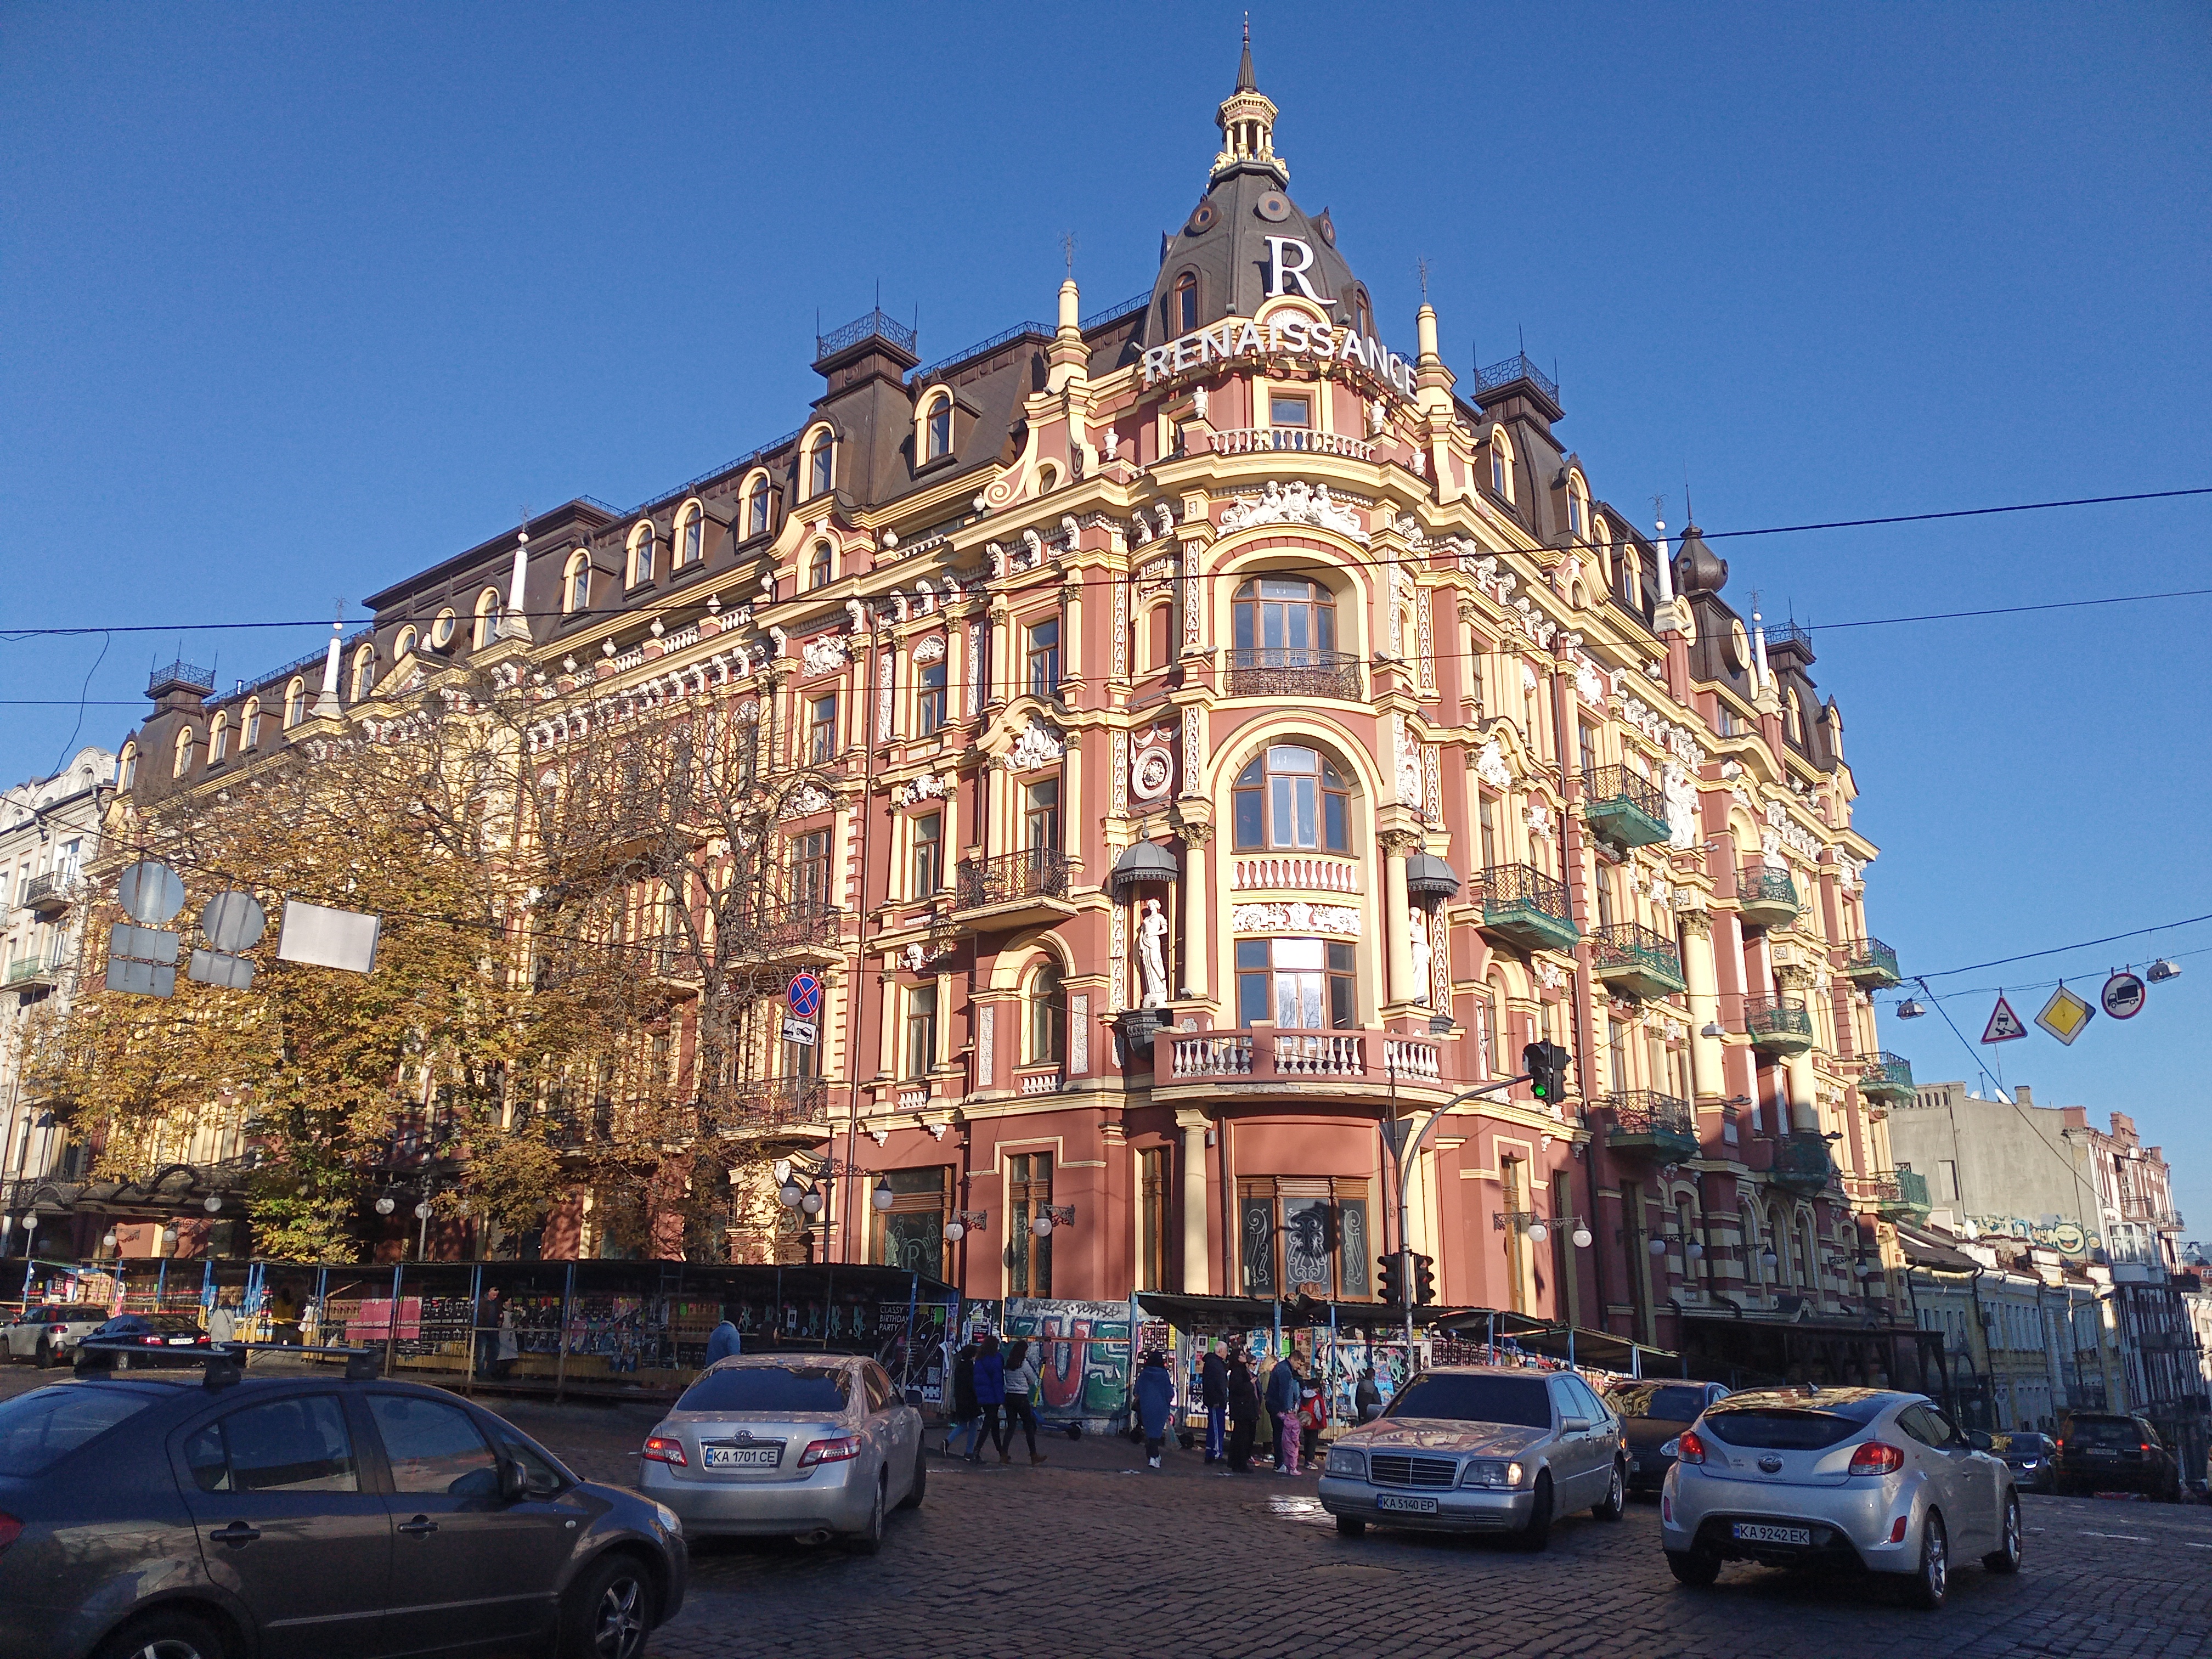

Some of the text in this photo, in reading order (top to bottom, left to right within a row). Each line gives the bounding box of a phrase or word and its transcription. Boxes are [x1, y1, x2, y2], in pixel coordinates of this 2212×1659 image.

[1265, 235, 1338, 305] R
[1145, 319, 1419, 405] RENAISSANCE
[880, 1306, 904, 1314] CLASSY
[879, 1314, 910, 1323] BIRTHDAY
[879, 1323, 899, 1331] PARTY
[713, 1451, 776, 1462] KA 1701 CE
[1383, 1498, 1434, 1511] KA 5140 EP
[1740, 1525, 1809, 1543] KA 9242 EK
